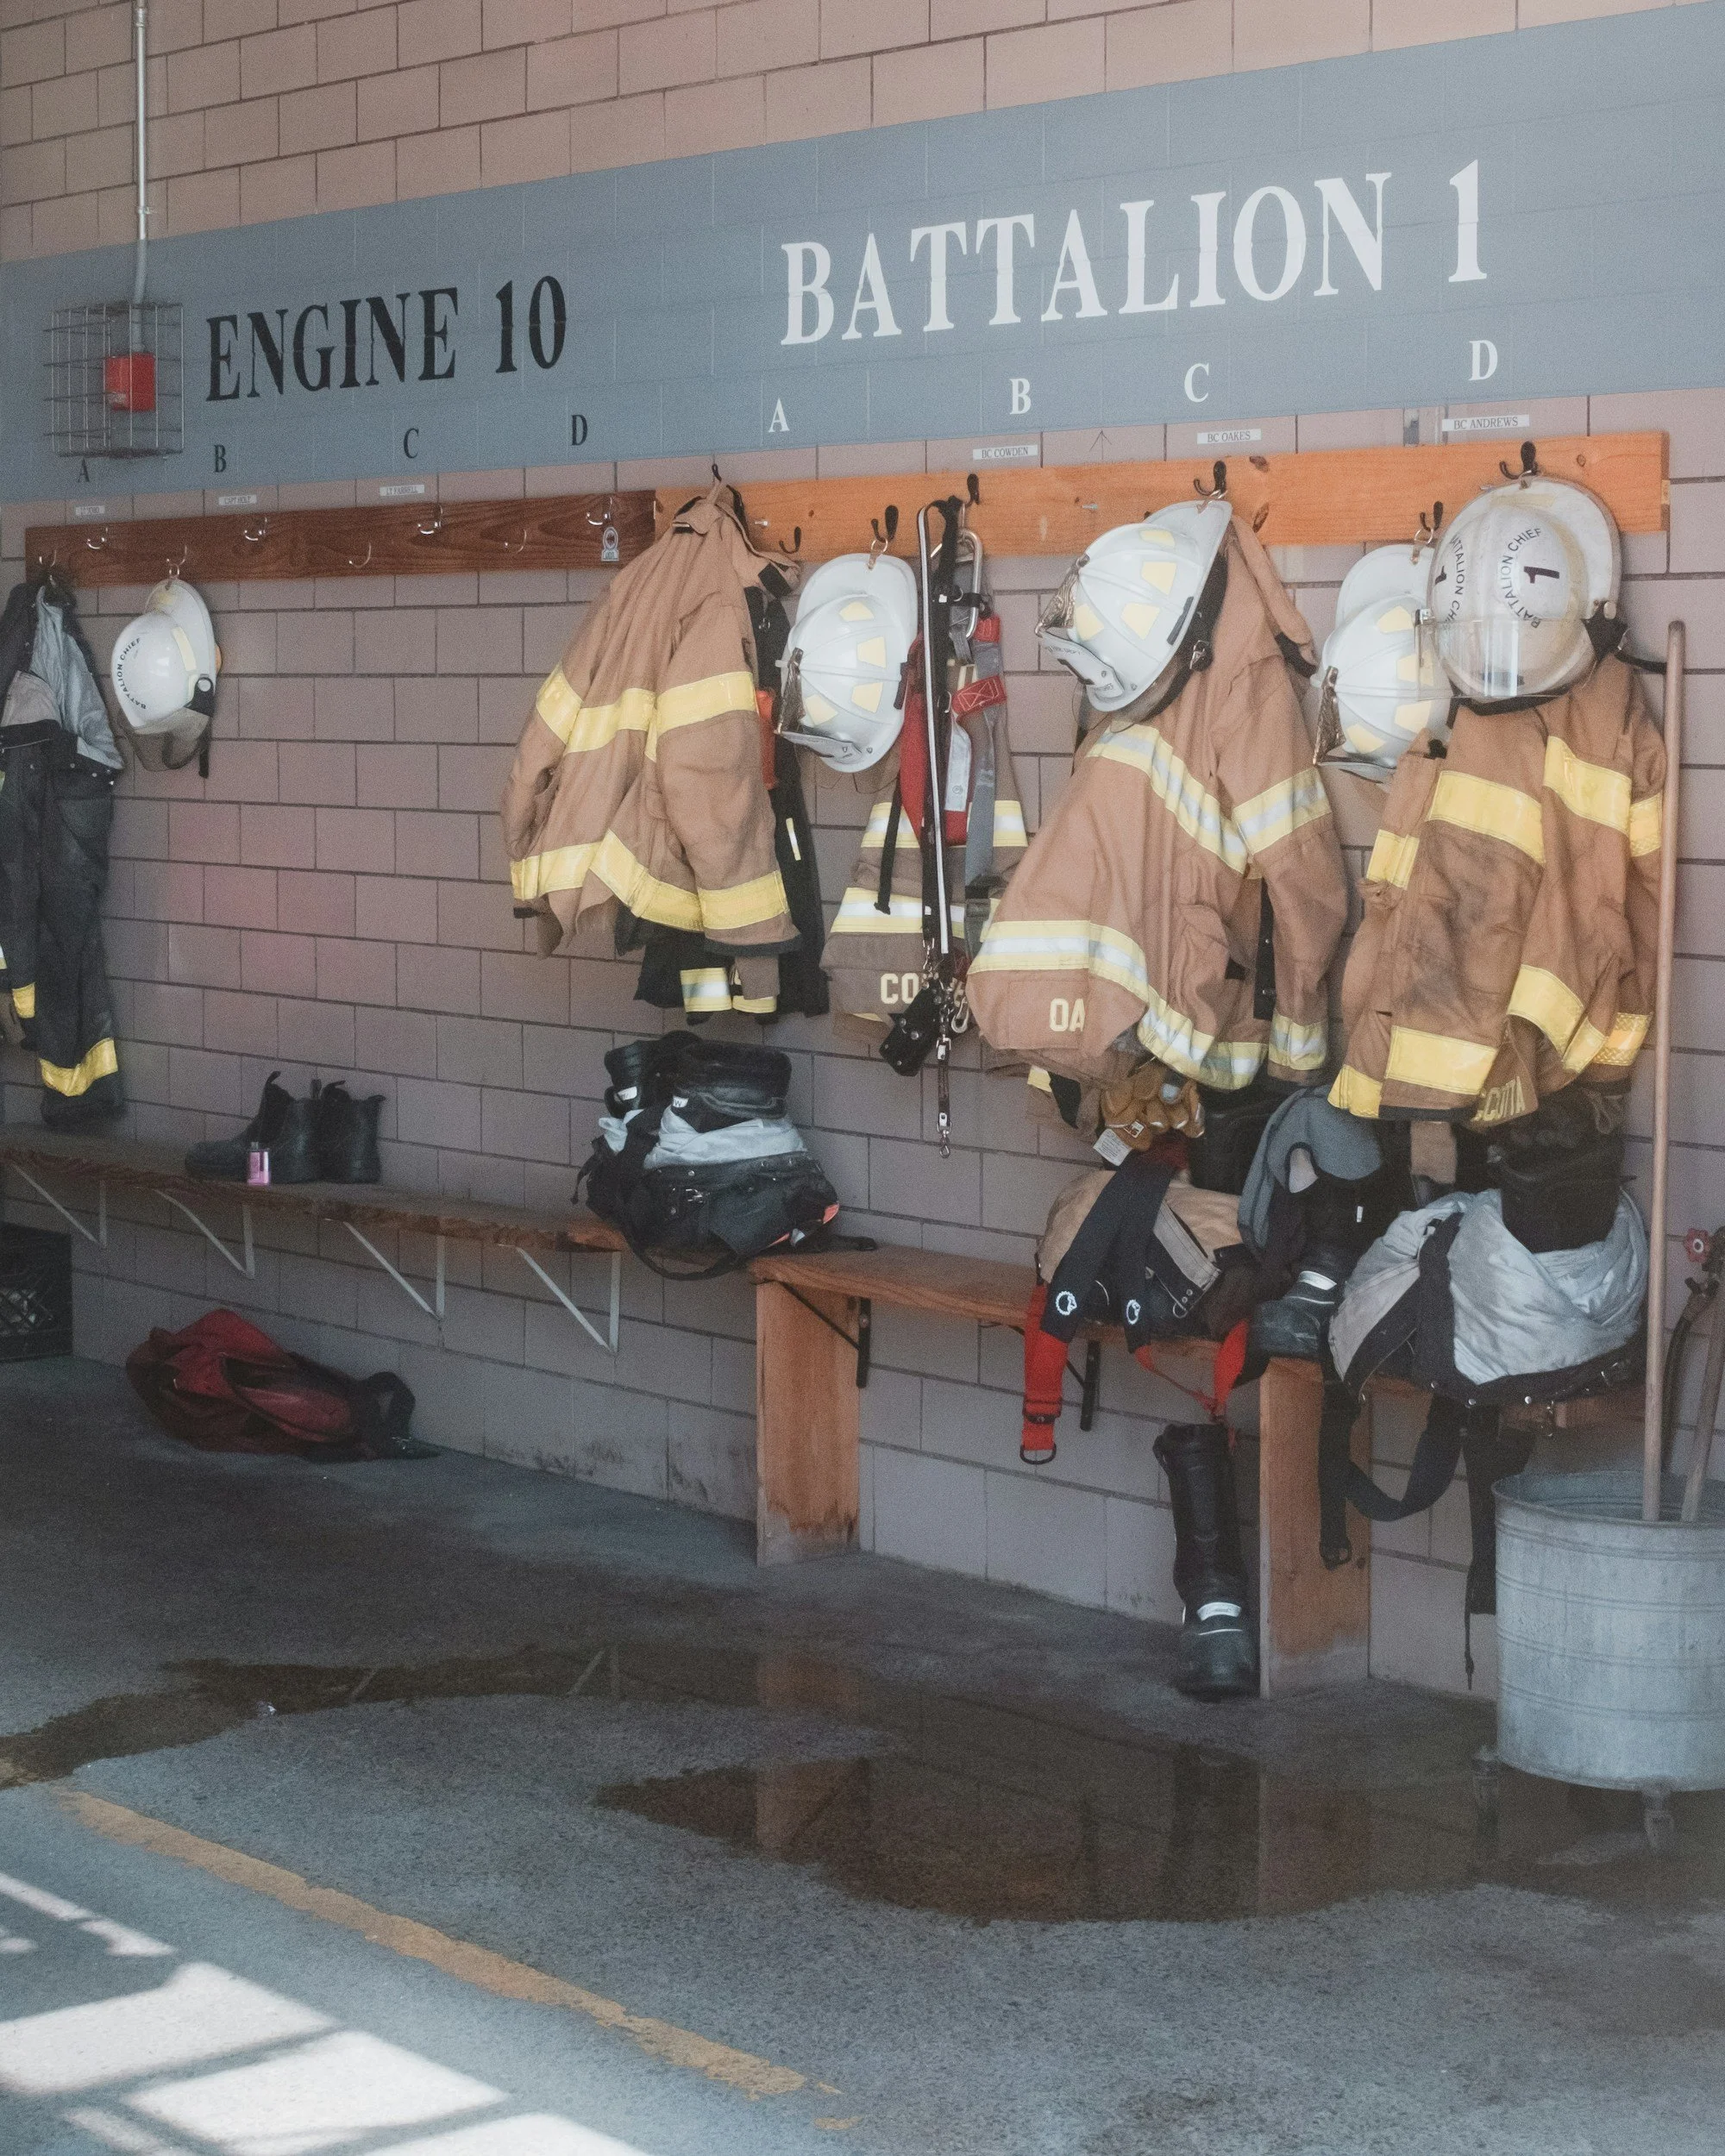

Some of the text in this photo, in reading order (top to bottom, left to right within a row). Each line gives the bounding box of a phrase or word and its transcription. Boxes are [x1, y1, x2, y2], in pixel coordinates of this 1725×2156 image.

[781, 160, 1487, 345] BATTALION 1
[206, 276, 566, 401] ENGINE 10
[1469, 340, 1498, 381] D
[1009, 378, 1032, 415] B
[1184, 363, 1209, 403] C
[572, 414, 587, 446] D
[768, 398, 789, 433] A
[1453, 417, 1518, 429] BC ANDREWS
[404, 428, 419, 459] C
[982, 447, 1028, 458] BC COWDEN
[1208, 430, 1251, 442] BC OAKES
[78, 457, 90, 482] A
[214, 444, 227, 473] B
[1500, 528, 1542, 629] BATTALION CHIEF
[1523, 566, 1560, 584] 1
[116, 637, 147, 709] BATTALION CHIEF
